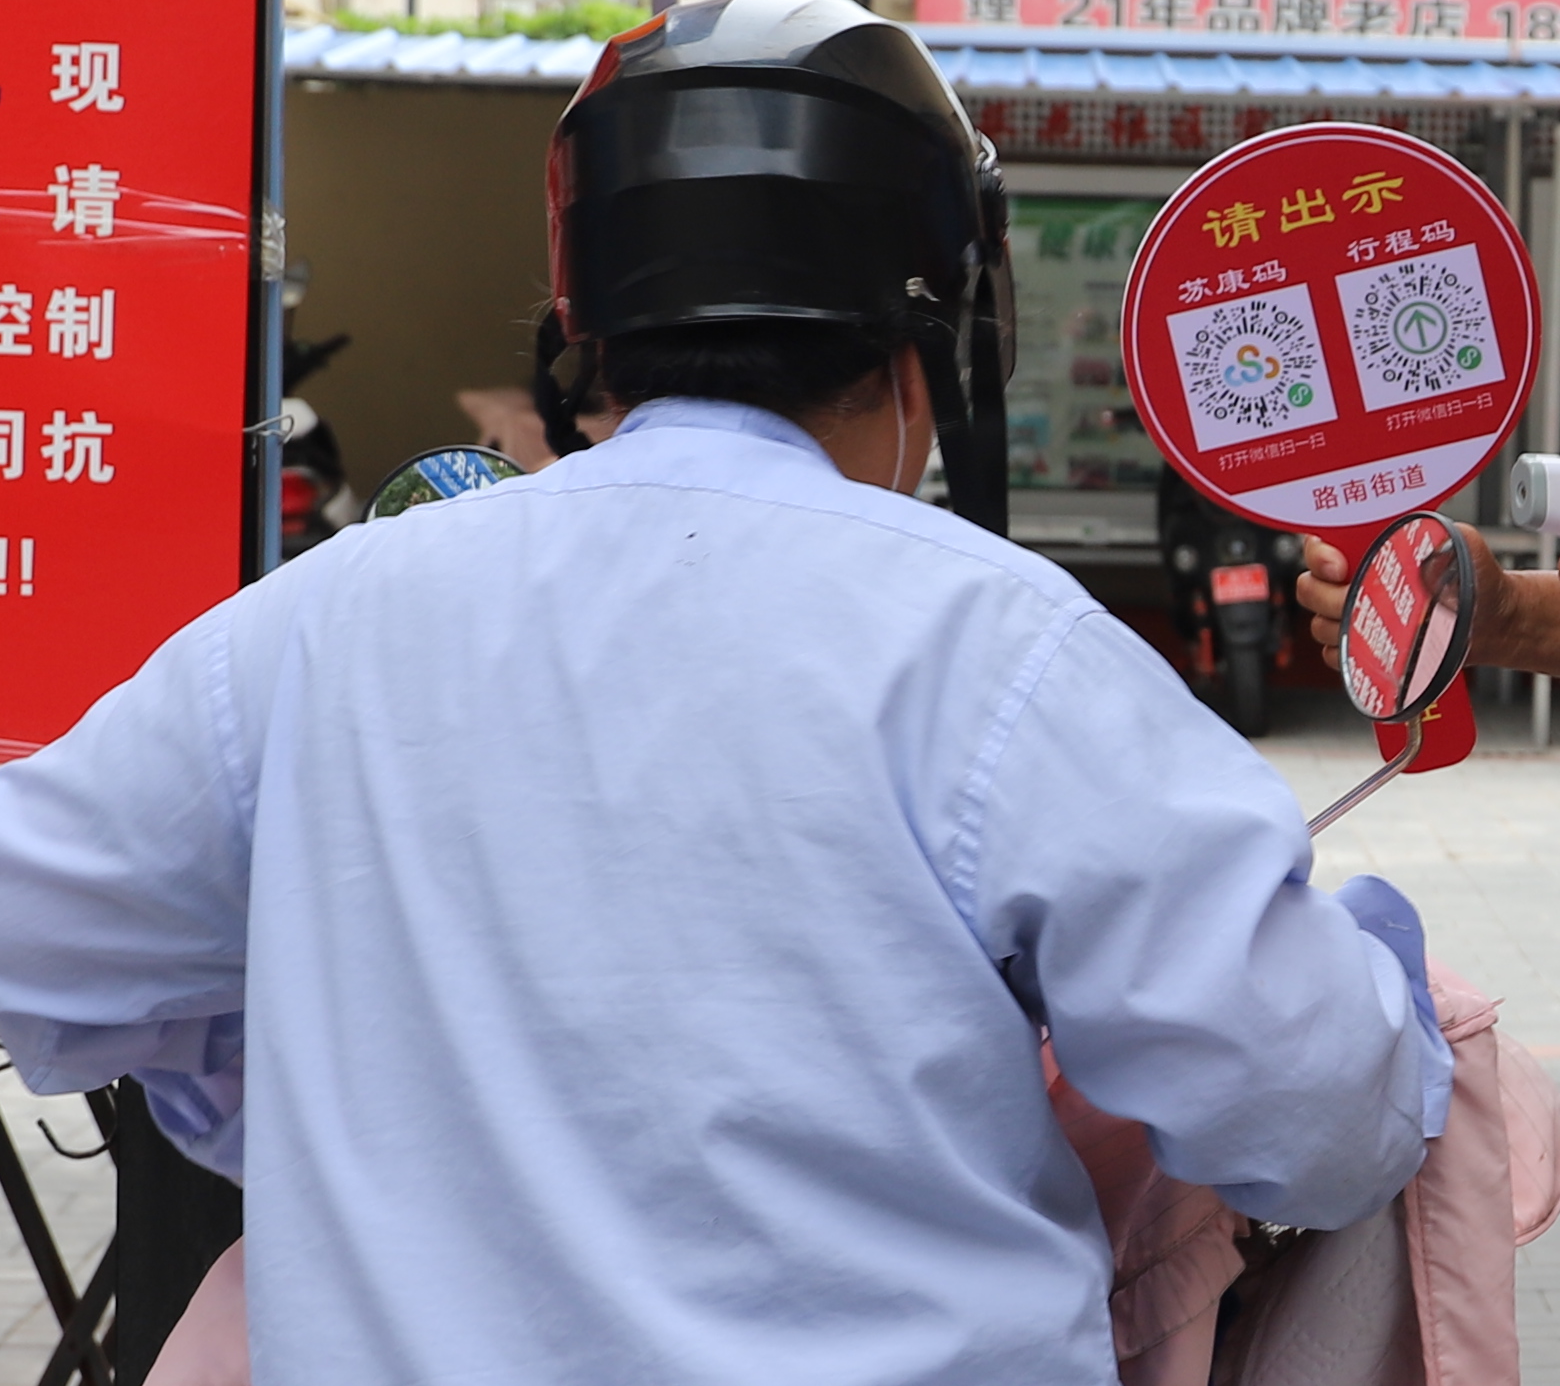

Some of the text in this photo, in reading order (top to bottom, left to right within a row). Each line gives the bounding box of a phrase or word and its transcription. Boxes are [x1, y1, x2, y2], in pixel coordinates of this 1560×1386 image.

[1202, 170, 1406, 251] 请出示
[1346, 219, 1456, 265] 行程码
[1177, 259, 1288, 305] 苏康码
[1385, 392, 1494, 432] 打开微信扫一扫
[1218, 431, 1327, 472] 打开微信扫一扫
[1312, 463, 1428, 512] 路南街道
